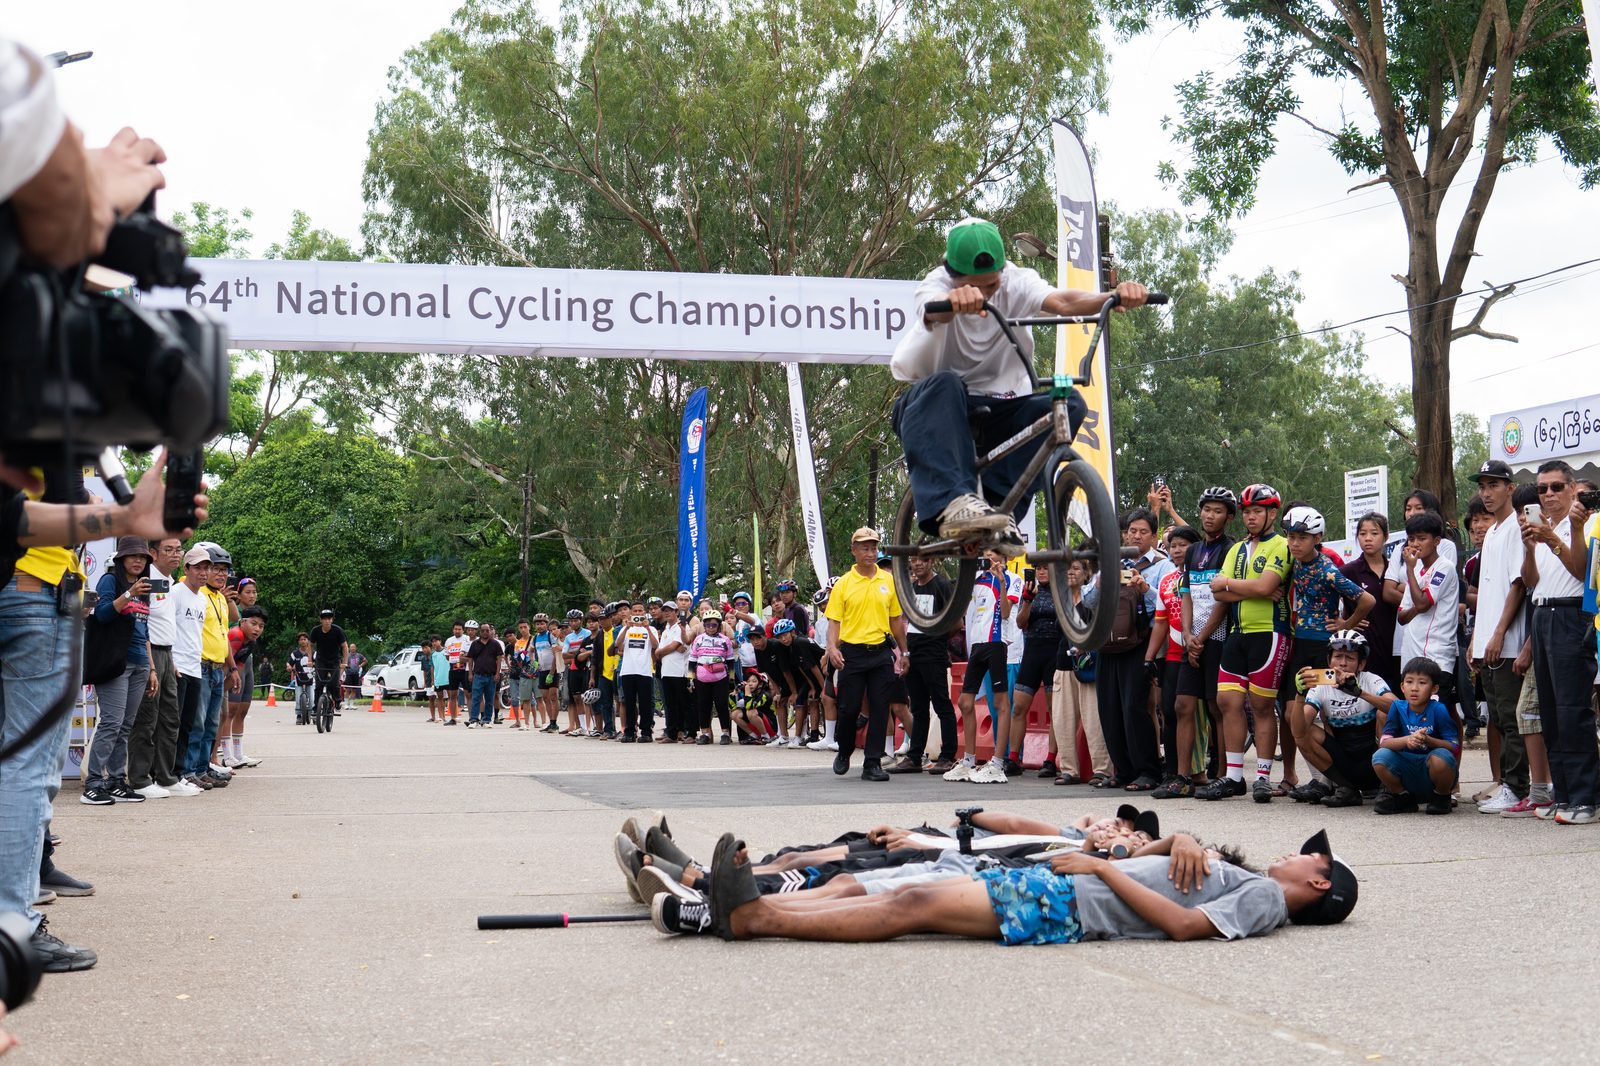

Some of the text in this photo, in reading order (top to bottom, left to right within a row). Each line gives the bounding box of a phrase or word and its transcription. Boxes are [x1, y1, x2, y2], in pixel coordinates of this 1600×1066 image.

[185, 277, 906, 340] 64th National Cycling Championship
